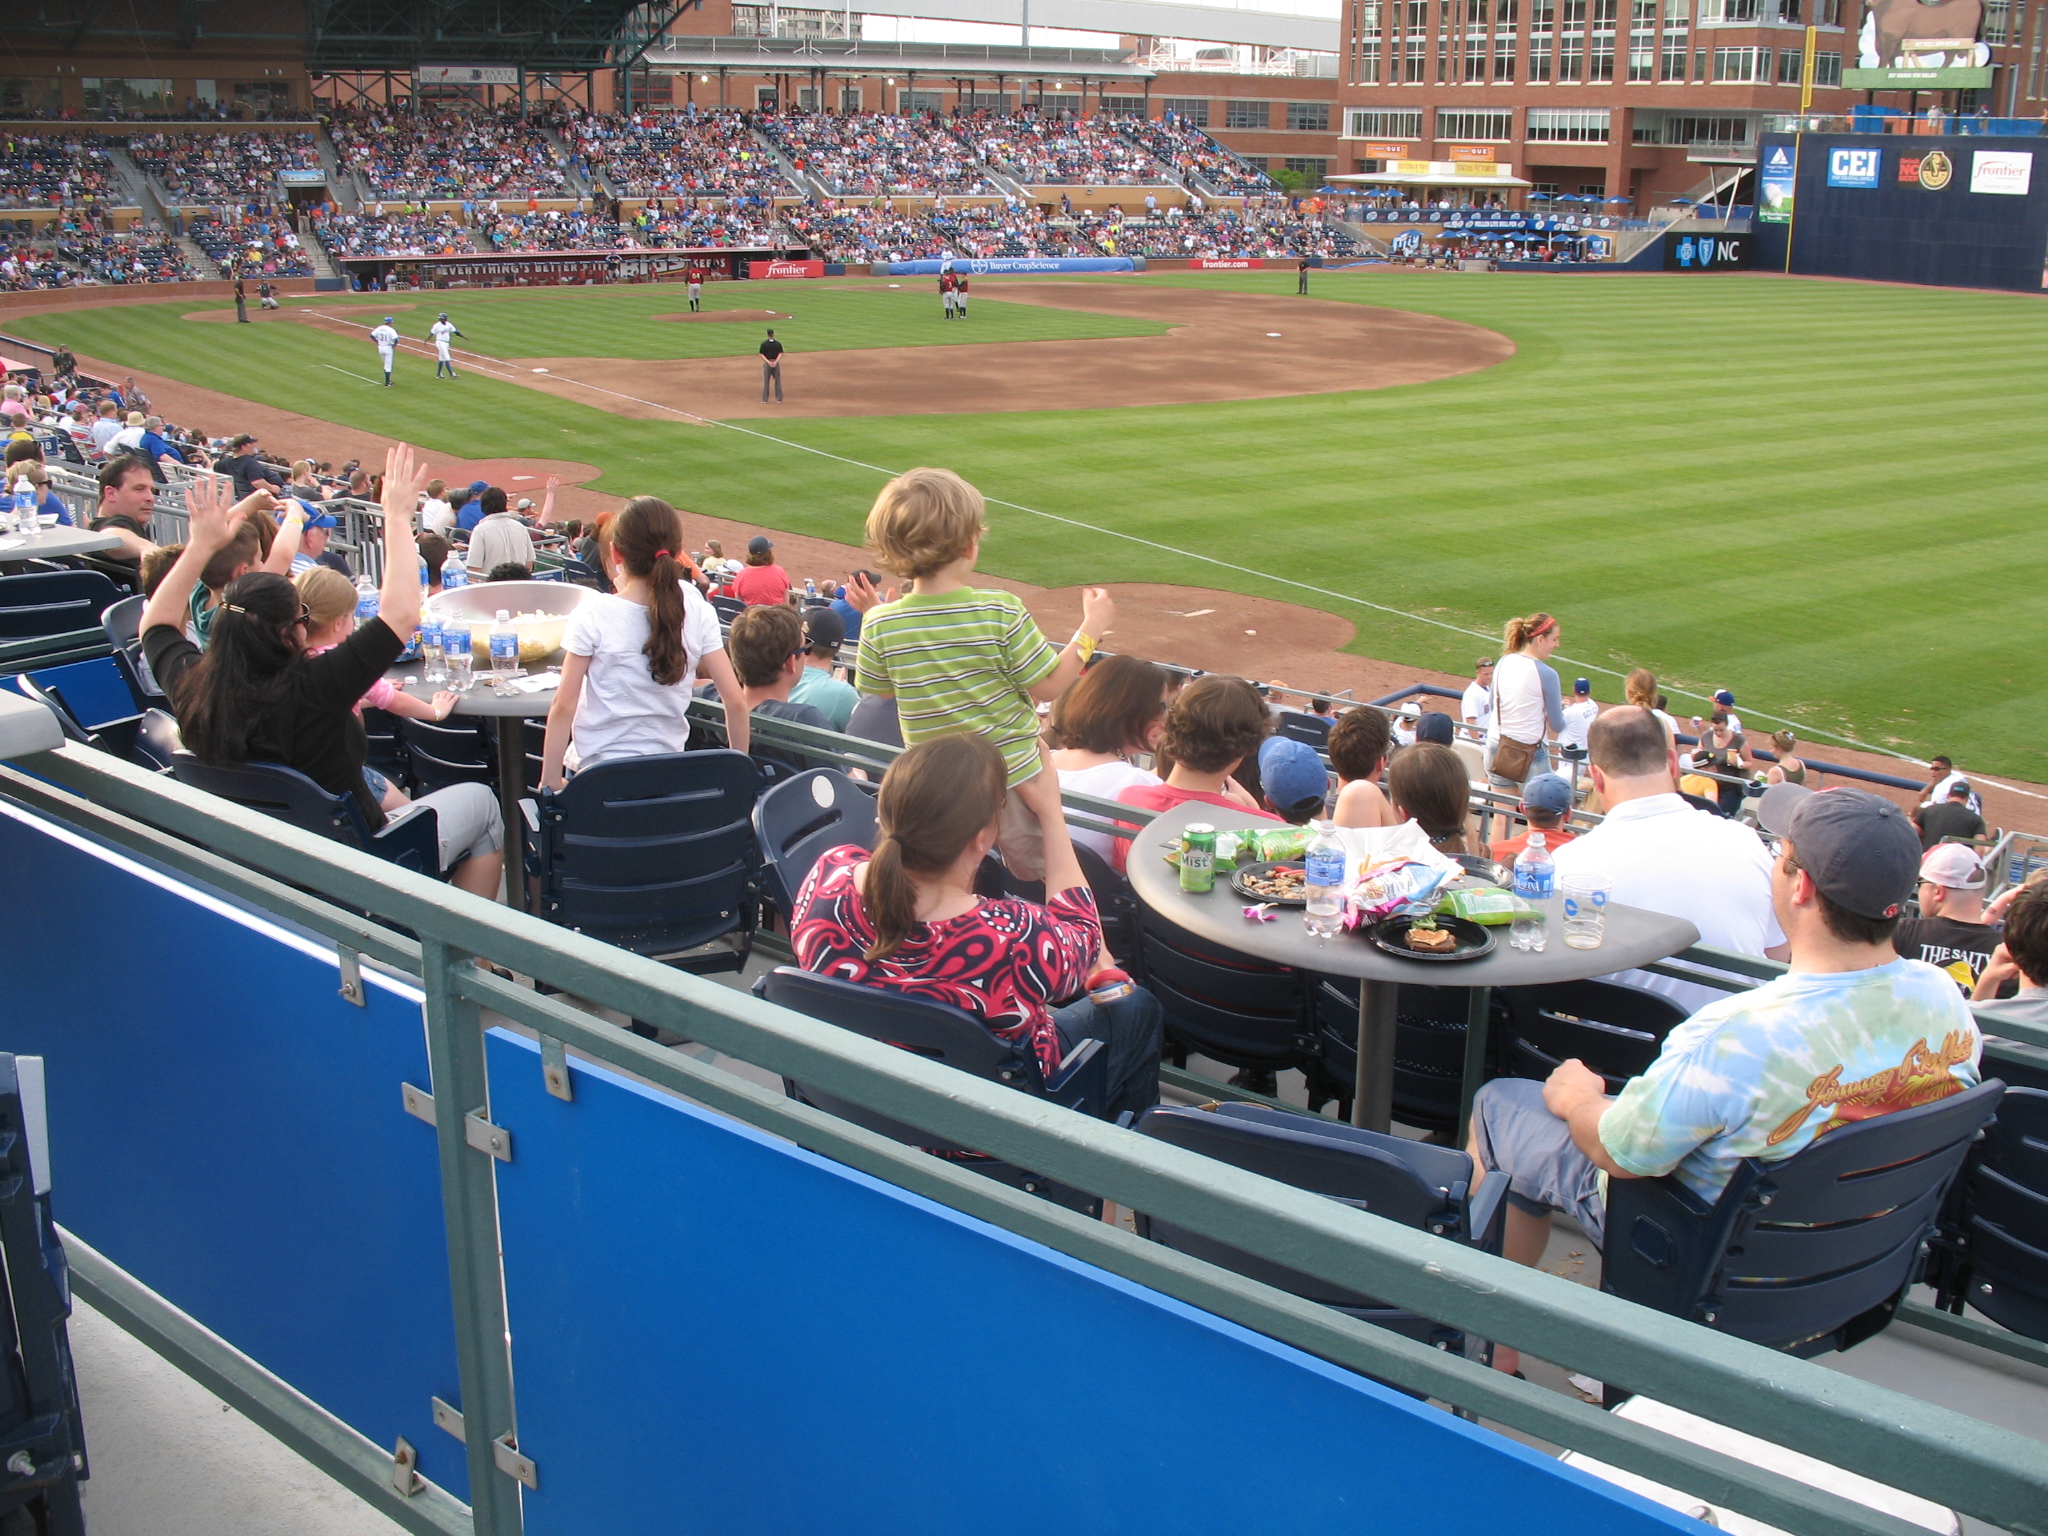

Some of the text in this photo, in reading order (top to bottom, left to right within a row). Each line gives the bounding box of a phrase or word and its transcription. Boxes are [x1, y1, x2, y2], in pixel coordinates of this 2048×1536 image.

[1831, 150, 1878, 177] CEI
[1899, 163, 1920, 175] NC
[1974, 161, 2026, 179] frontier
[1717, 241, 1740, 261] NC
[765, 262, 808, 278] frontier
[990, 261, 1060, 271] Bayer CropScience
[1202, 260, 1249, 268] frontier.com
[1920, 944, 1992, 976] THE SALTY
